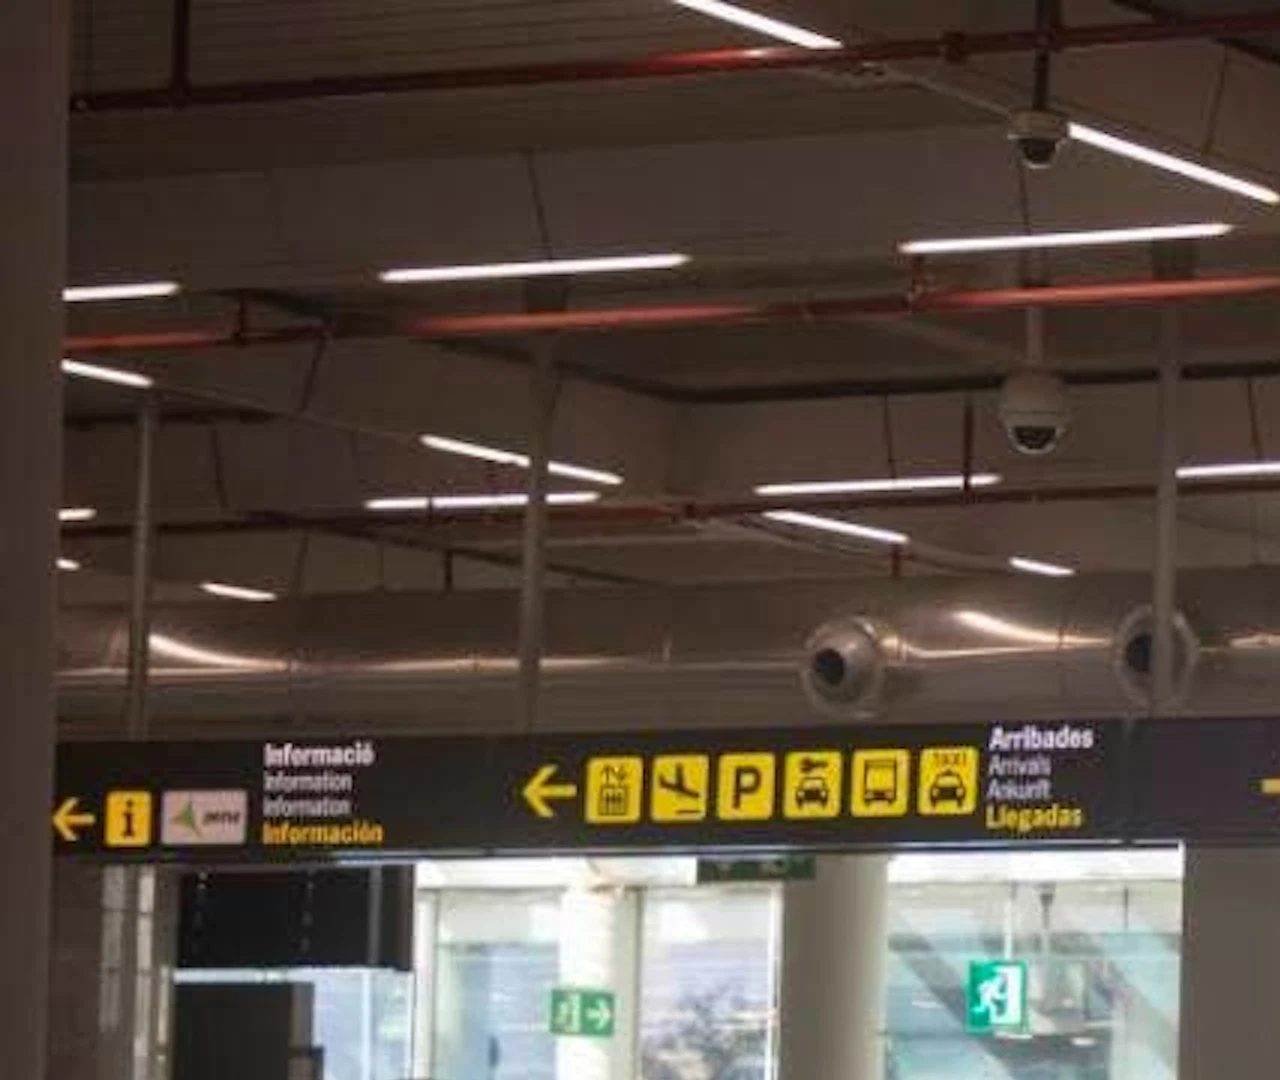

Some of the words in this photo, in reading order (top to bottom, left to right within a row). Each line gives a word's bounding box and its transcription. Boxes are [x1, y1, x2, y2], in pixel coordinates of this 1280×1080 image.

[988, 724, 1094, 751] Arribades
[264, 741, 375, 768] Informació
[263, 770, 353, 792] Information
[733, 767, 762, 809] P
[985, 803, 1083, 832] Llegadas
[263, 820, 384, 845] Información
